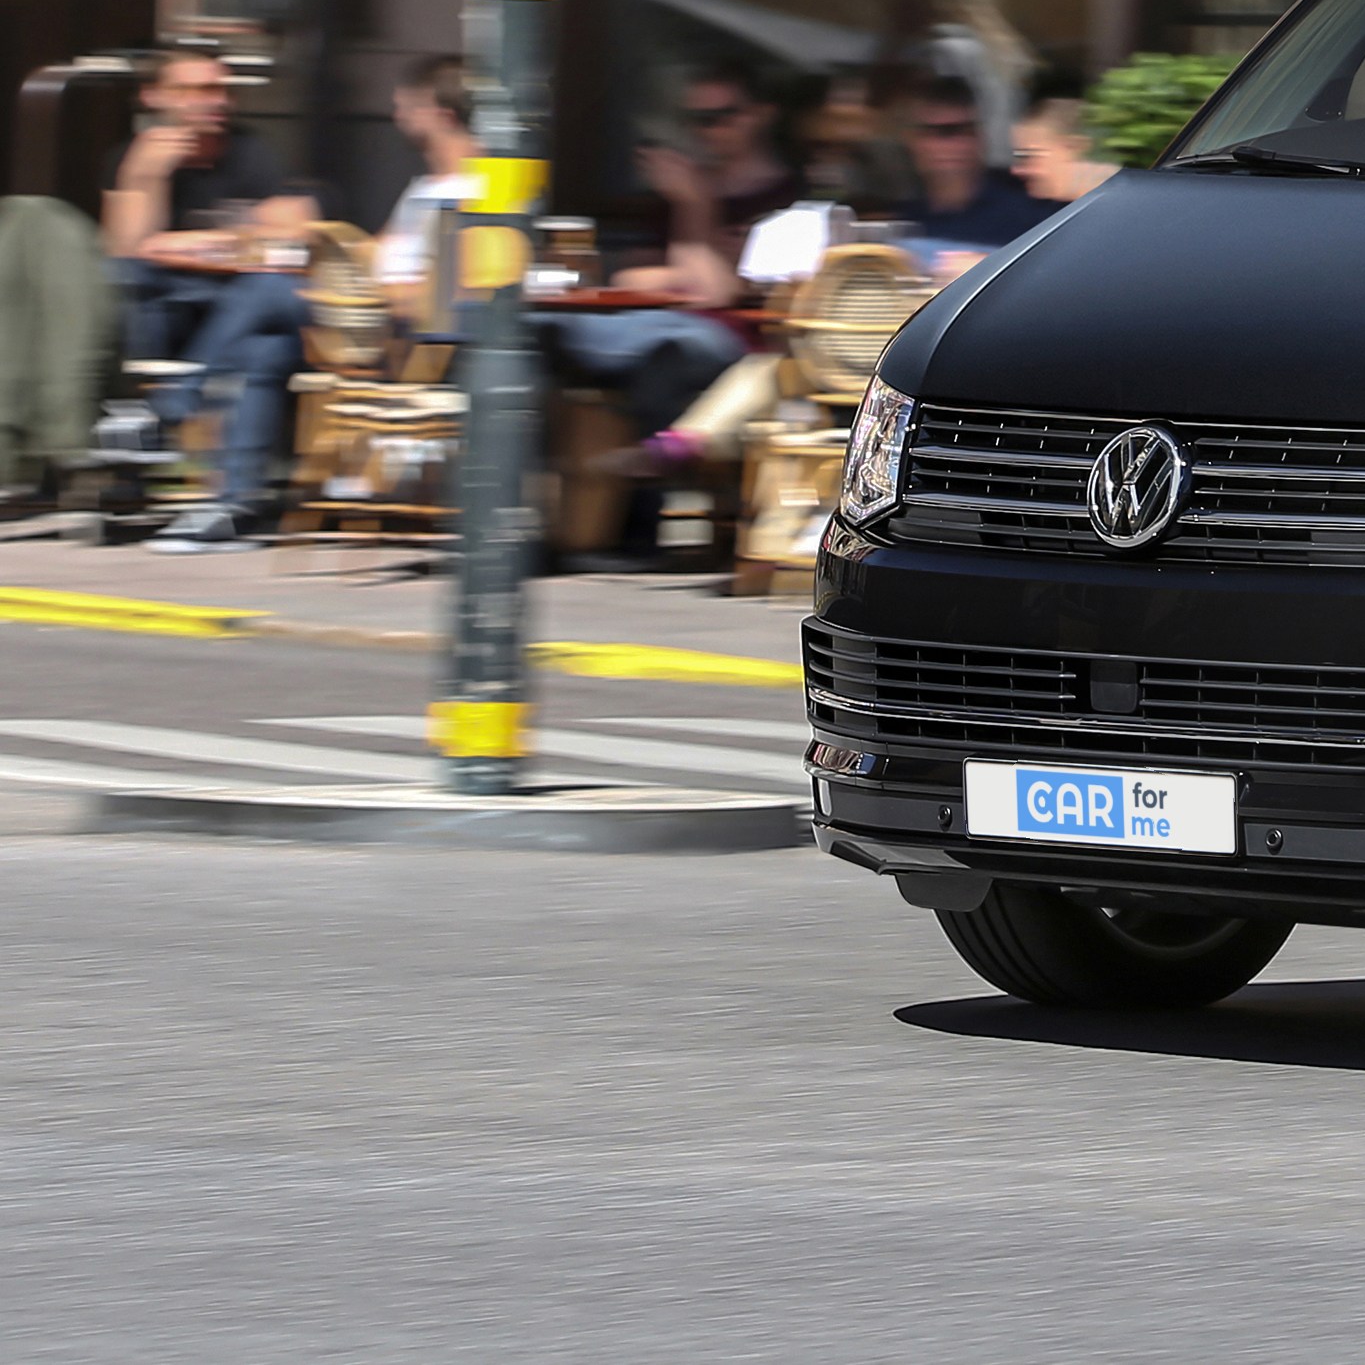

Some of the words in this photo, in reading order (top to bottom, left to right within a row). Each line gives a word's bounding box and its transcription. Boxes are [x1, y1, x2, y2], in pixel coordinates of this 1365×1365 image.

[1026, 780, 1114, 828] CAR
[1132, 782, 1168, 809] for
[1131, 815, 1171, 838] me
